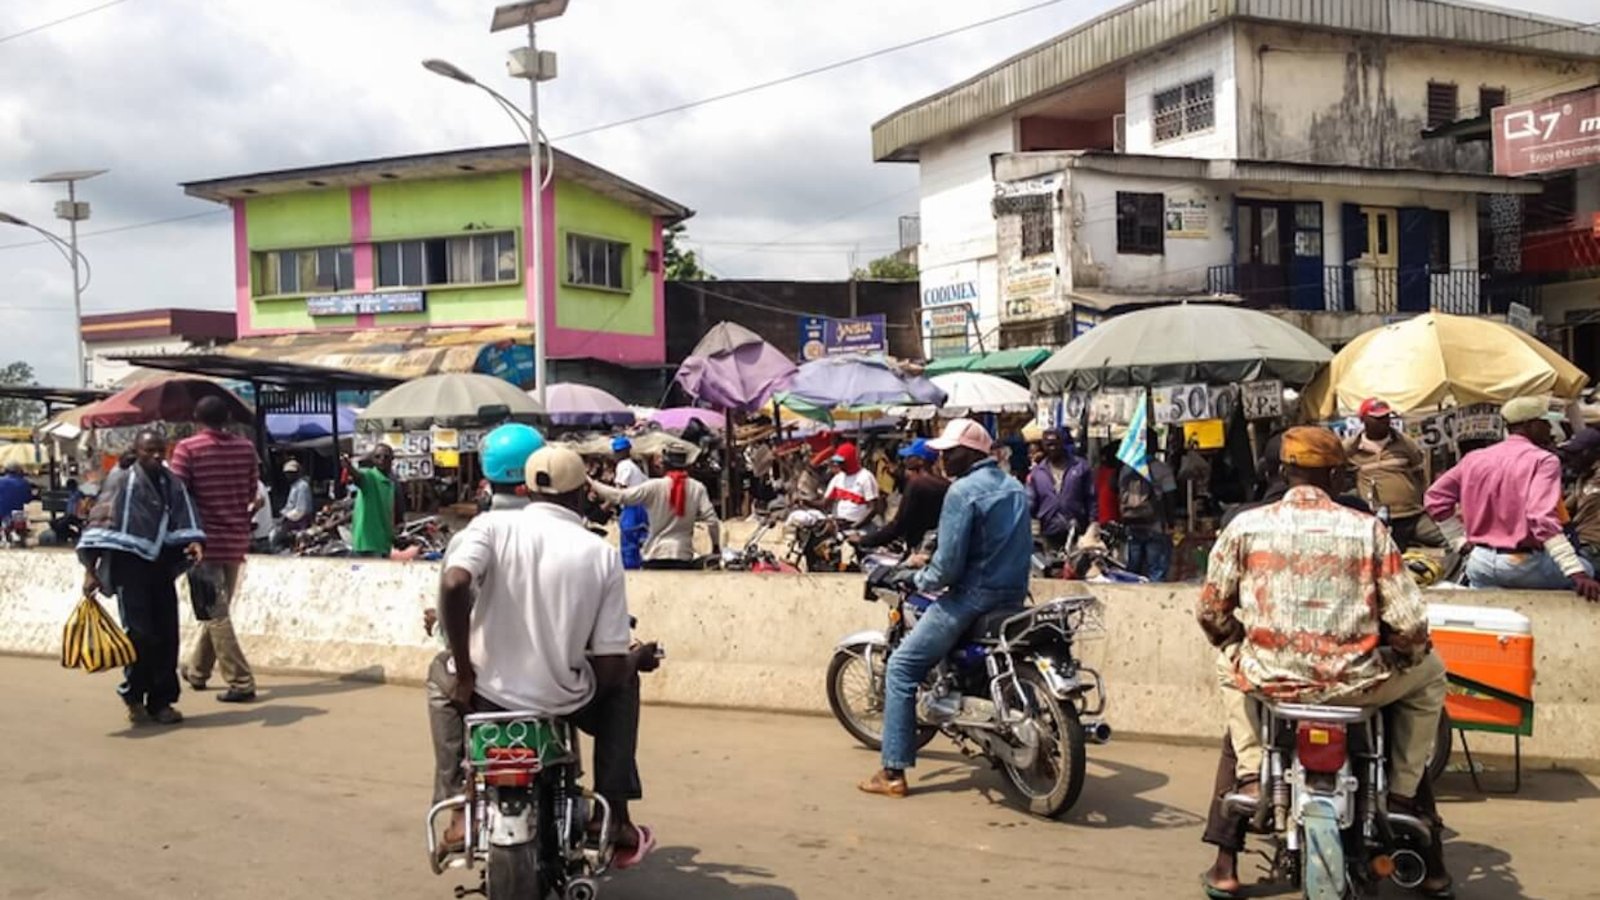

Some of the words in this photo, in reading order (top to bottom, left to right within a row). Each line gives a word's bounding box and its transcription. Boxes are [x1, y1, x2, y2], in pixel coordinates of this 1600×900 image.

[1530, 150, 1554, 164] Enjoy
[1556, 149, 1571, 160] the
[924, 281, 977, 306] CODIMEX
[1170, 385, 1206, 420] 50
[407, 436, 431, 455] 50
